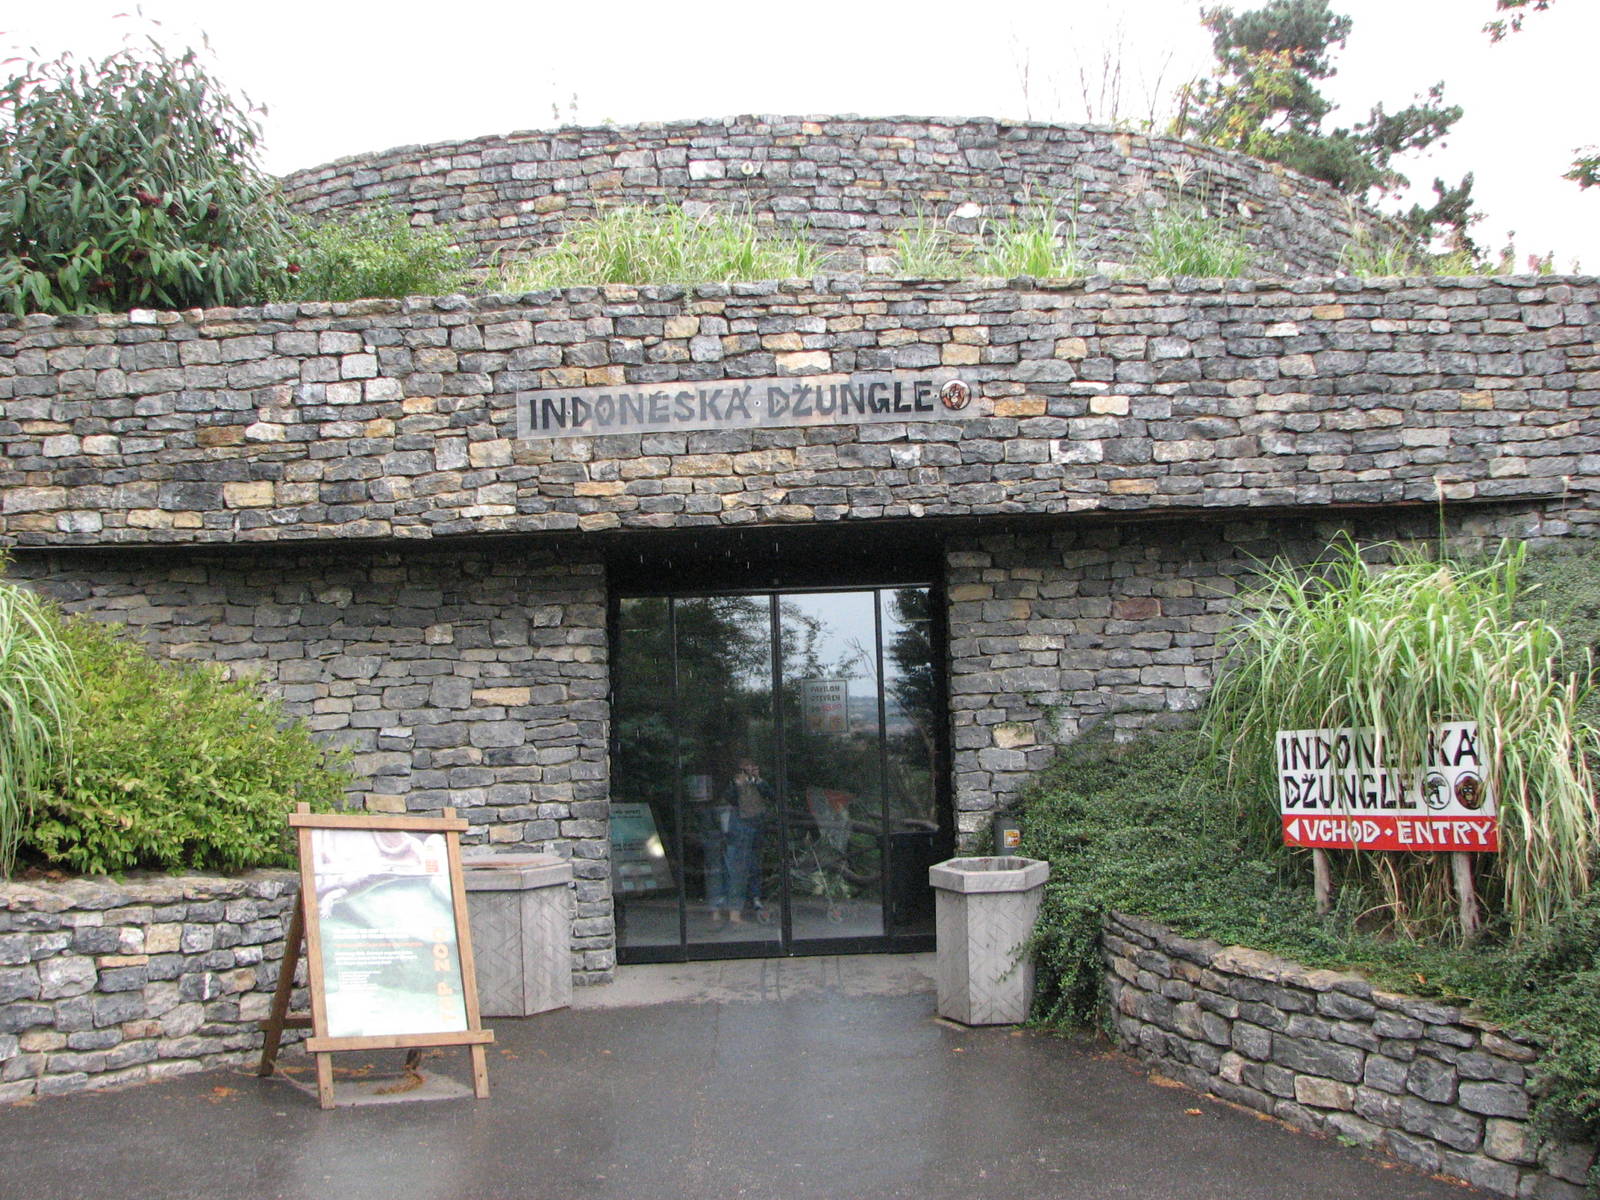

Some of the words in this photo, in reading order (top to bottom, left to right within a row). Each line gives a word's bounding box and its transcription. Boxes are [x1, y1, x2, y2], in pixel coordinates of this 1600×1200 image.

[529, 384, 752, 430] INDONÉSKÁ
[767, 380, 934, 418] DŽUNGLE
[1283, 773, 1417, 809] DŽUNGLE
[1302, 819, 1381, 843] VCHOD
[1397, 820, 1492, 845] ENTRY
[432, 927, 451, 972] ZOO
